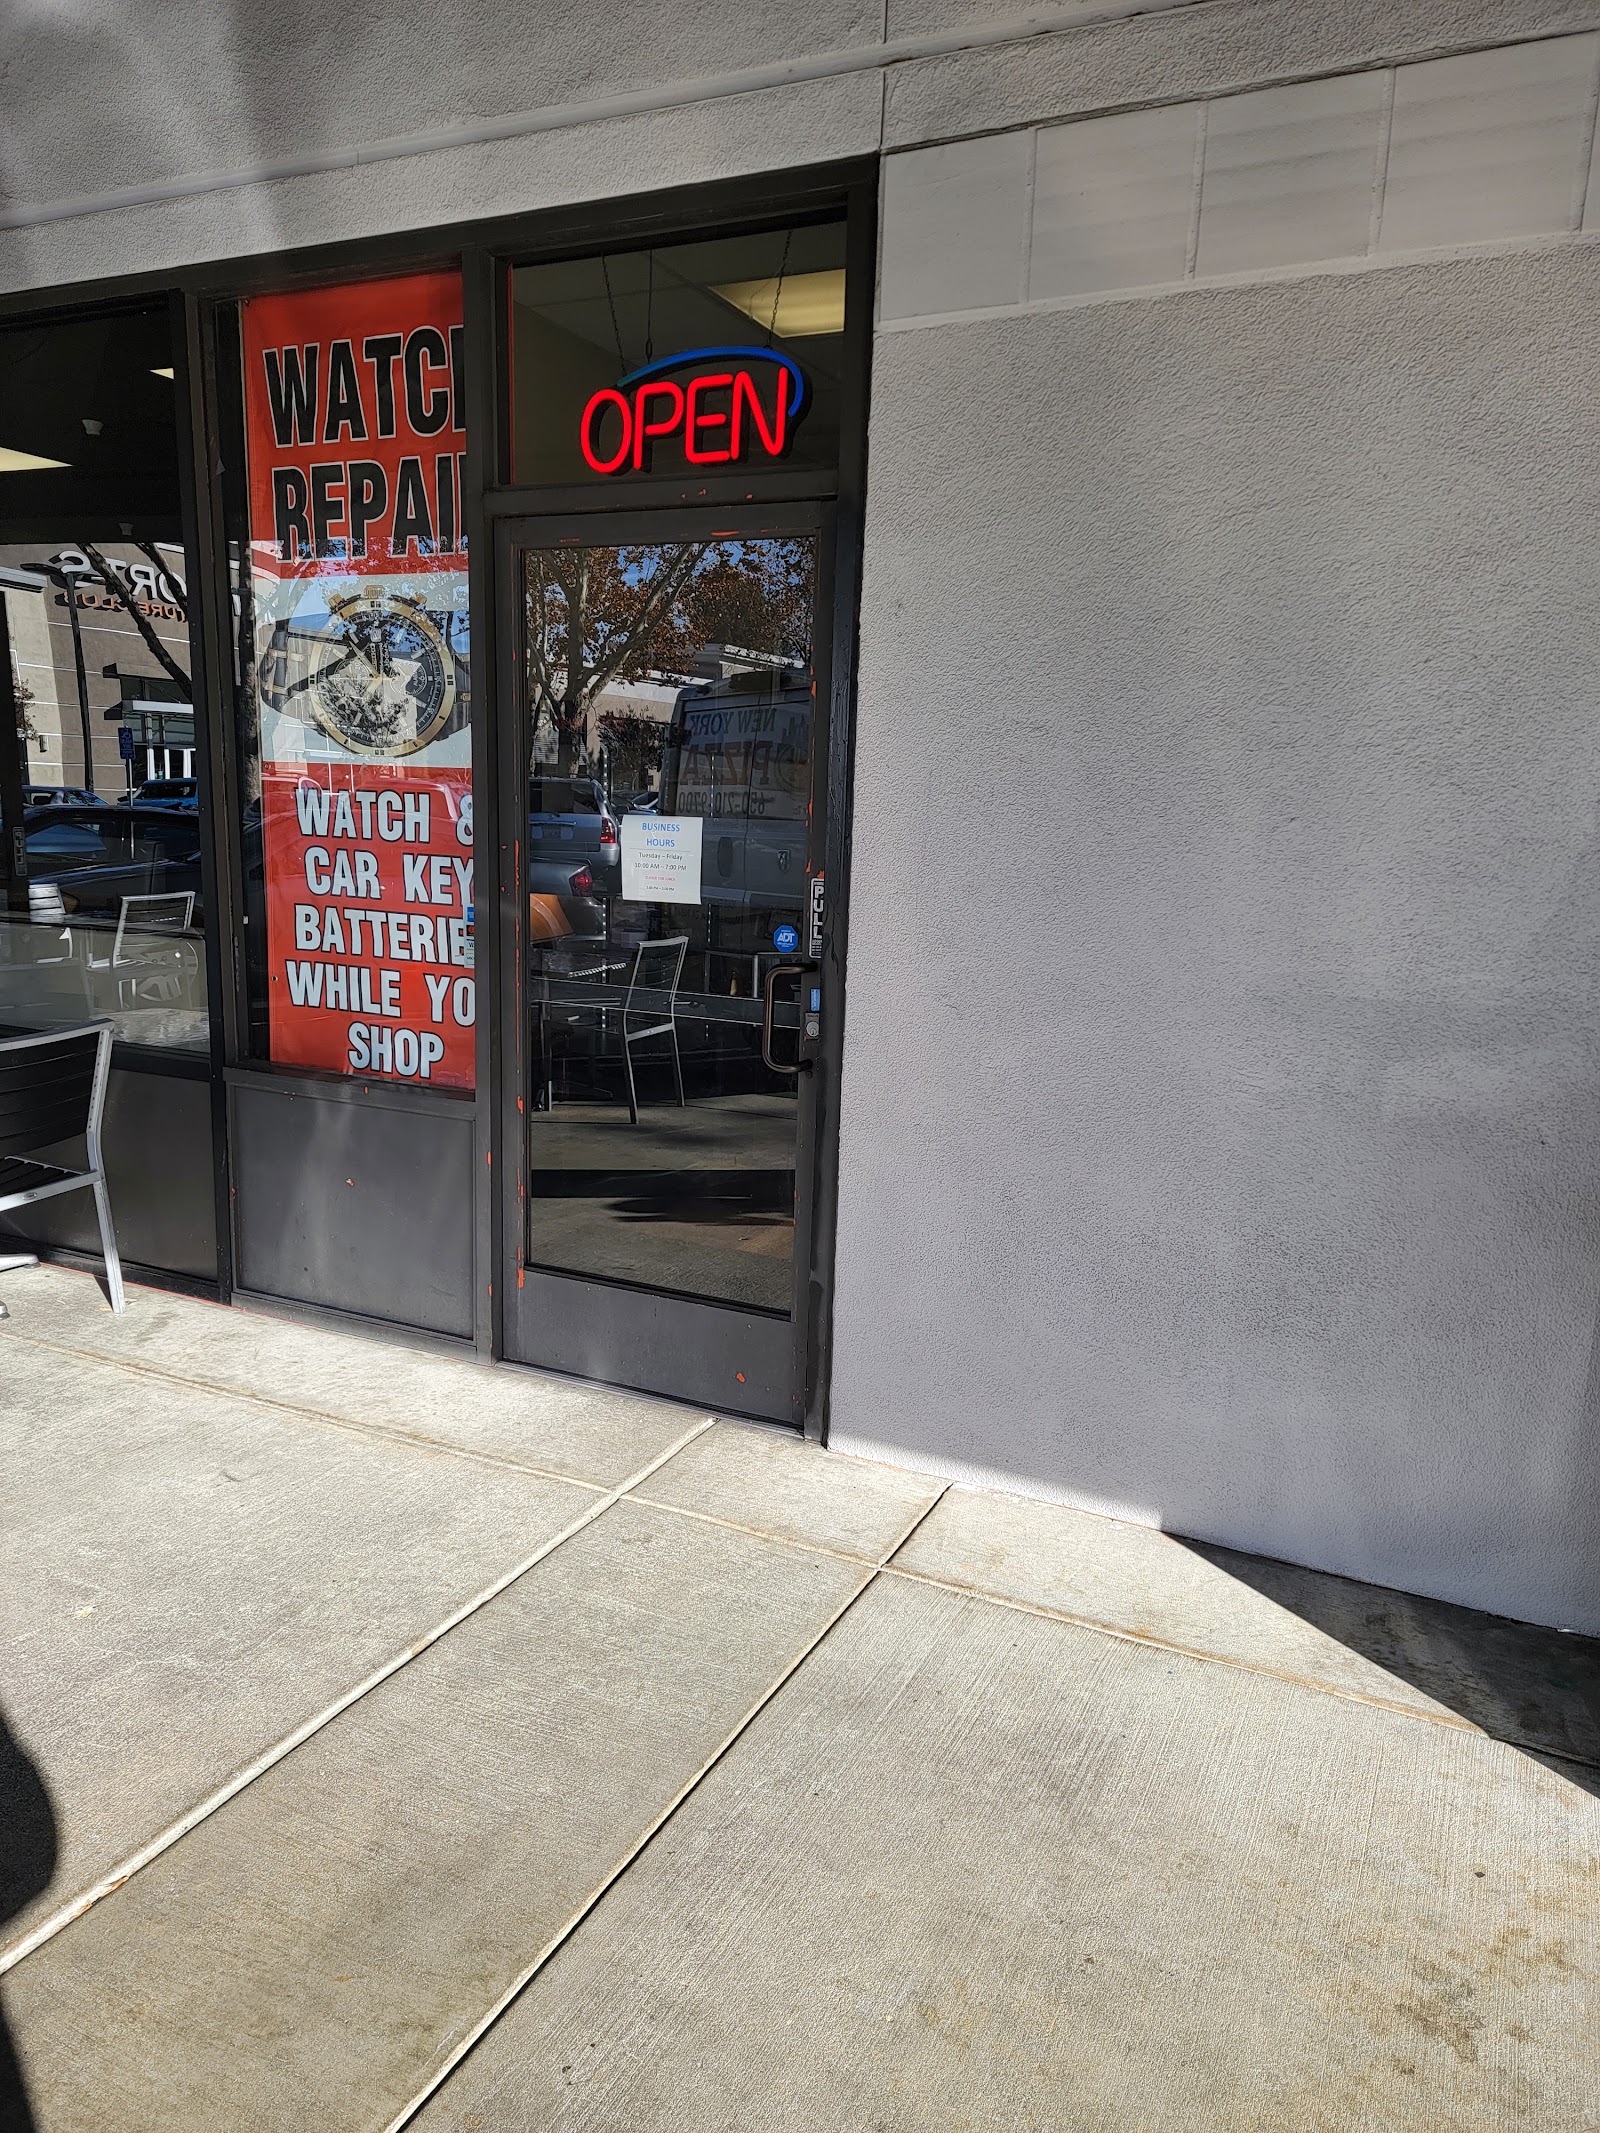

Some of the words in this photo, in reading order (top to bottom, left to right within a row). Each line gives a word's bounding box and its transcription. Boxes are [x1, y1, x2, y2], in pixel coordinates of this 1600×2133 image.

[581, 367, 788, 473] OPEN
[272, 451, 468, 564] REPAI
[295, 787, 430, 843] WATCH
[641, 822, 681, 832] BUSINESS
[638, 851, 661, 860] Tuesday
[666, 853, 683, 861] Friday
[646, 838, 676, 848] HOURS
[304, 845, 382, 900] CAR
[776, 932, 796, 943] ADT
[813, 885, 825, 939] PULL
[285, 958, 402, 1018] WHILE
[347, 1020, 445, 1079] SHOP
